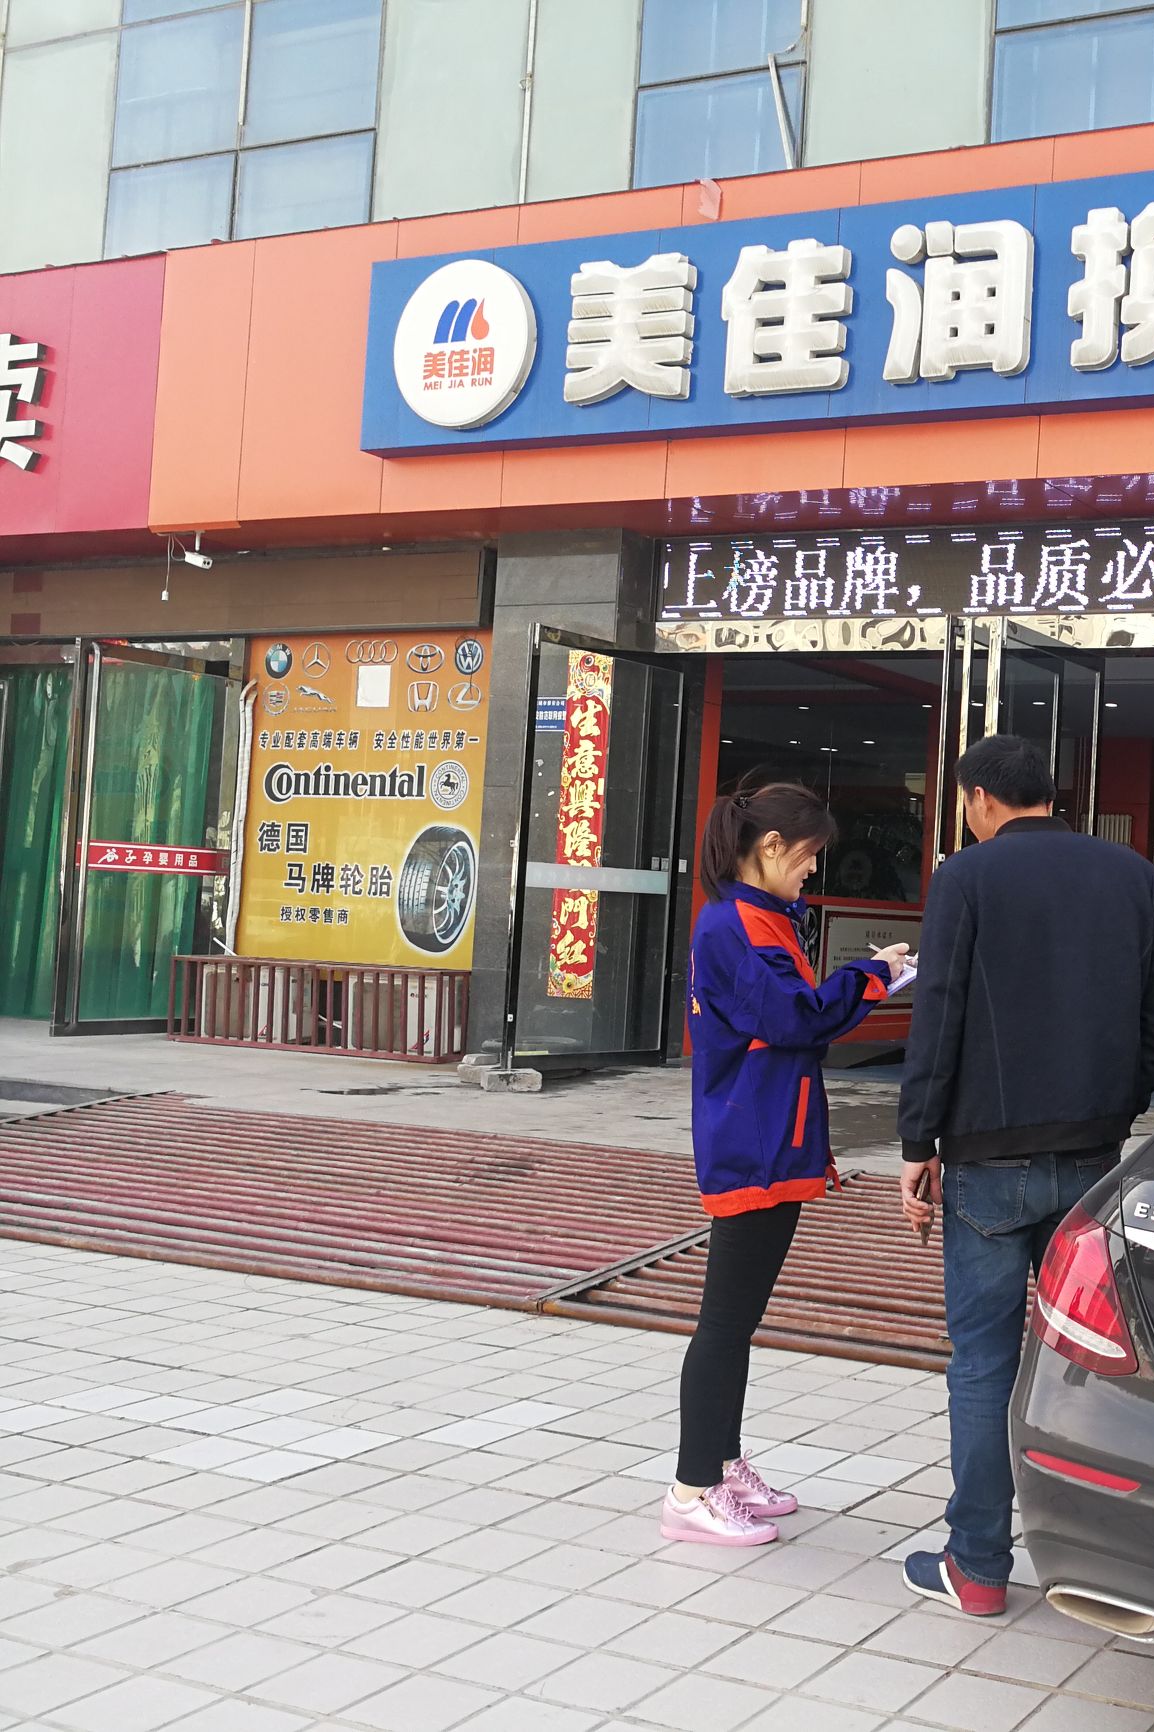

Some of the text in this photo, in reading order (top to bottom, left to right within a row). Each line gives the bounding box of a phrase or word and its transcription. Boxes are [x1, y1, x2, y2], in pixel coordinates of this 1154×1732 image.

[422, 346, 495, 380] 美佳润
[423, 377, 493, 391] MEI JIA RUN
[259, 730, 480, 750] 专业配套高端车辆 安全性能世界第一
[264, 762, 426, 803] Continental
[257, 822, 310, 855] 德国
[283, 862, 394, 898] 马牌轮胎
[280, 906, 350, 925] 授权零售商
